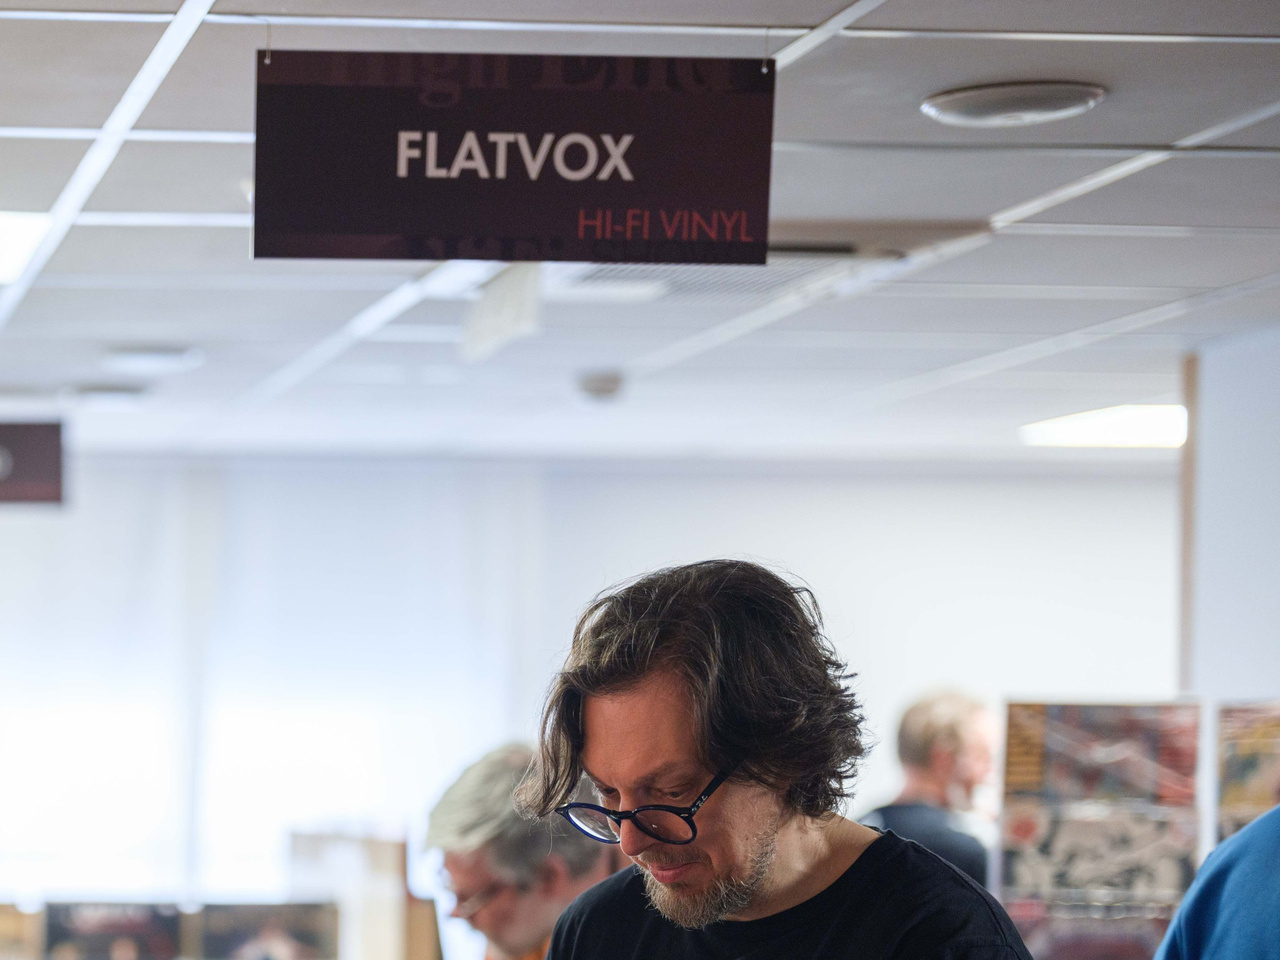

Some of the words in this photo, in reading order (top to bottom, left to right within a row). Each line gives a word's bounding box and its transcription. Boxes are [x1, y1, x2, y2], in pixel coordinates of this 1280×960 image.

[396, 130, 635, 181] FLATVOX
[577, 208, 651, 241] HI-FI
[659, 209, 755, 243] VINYL
